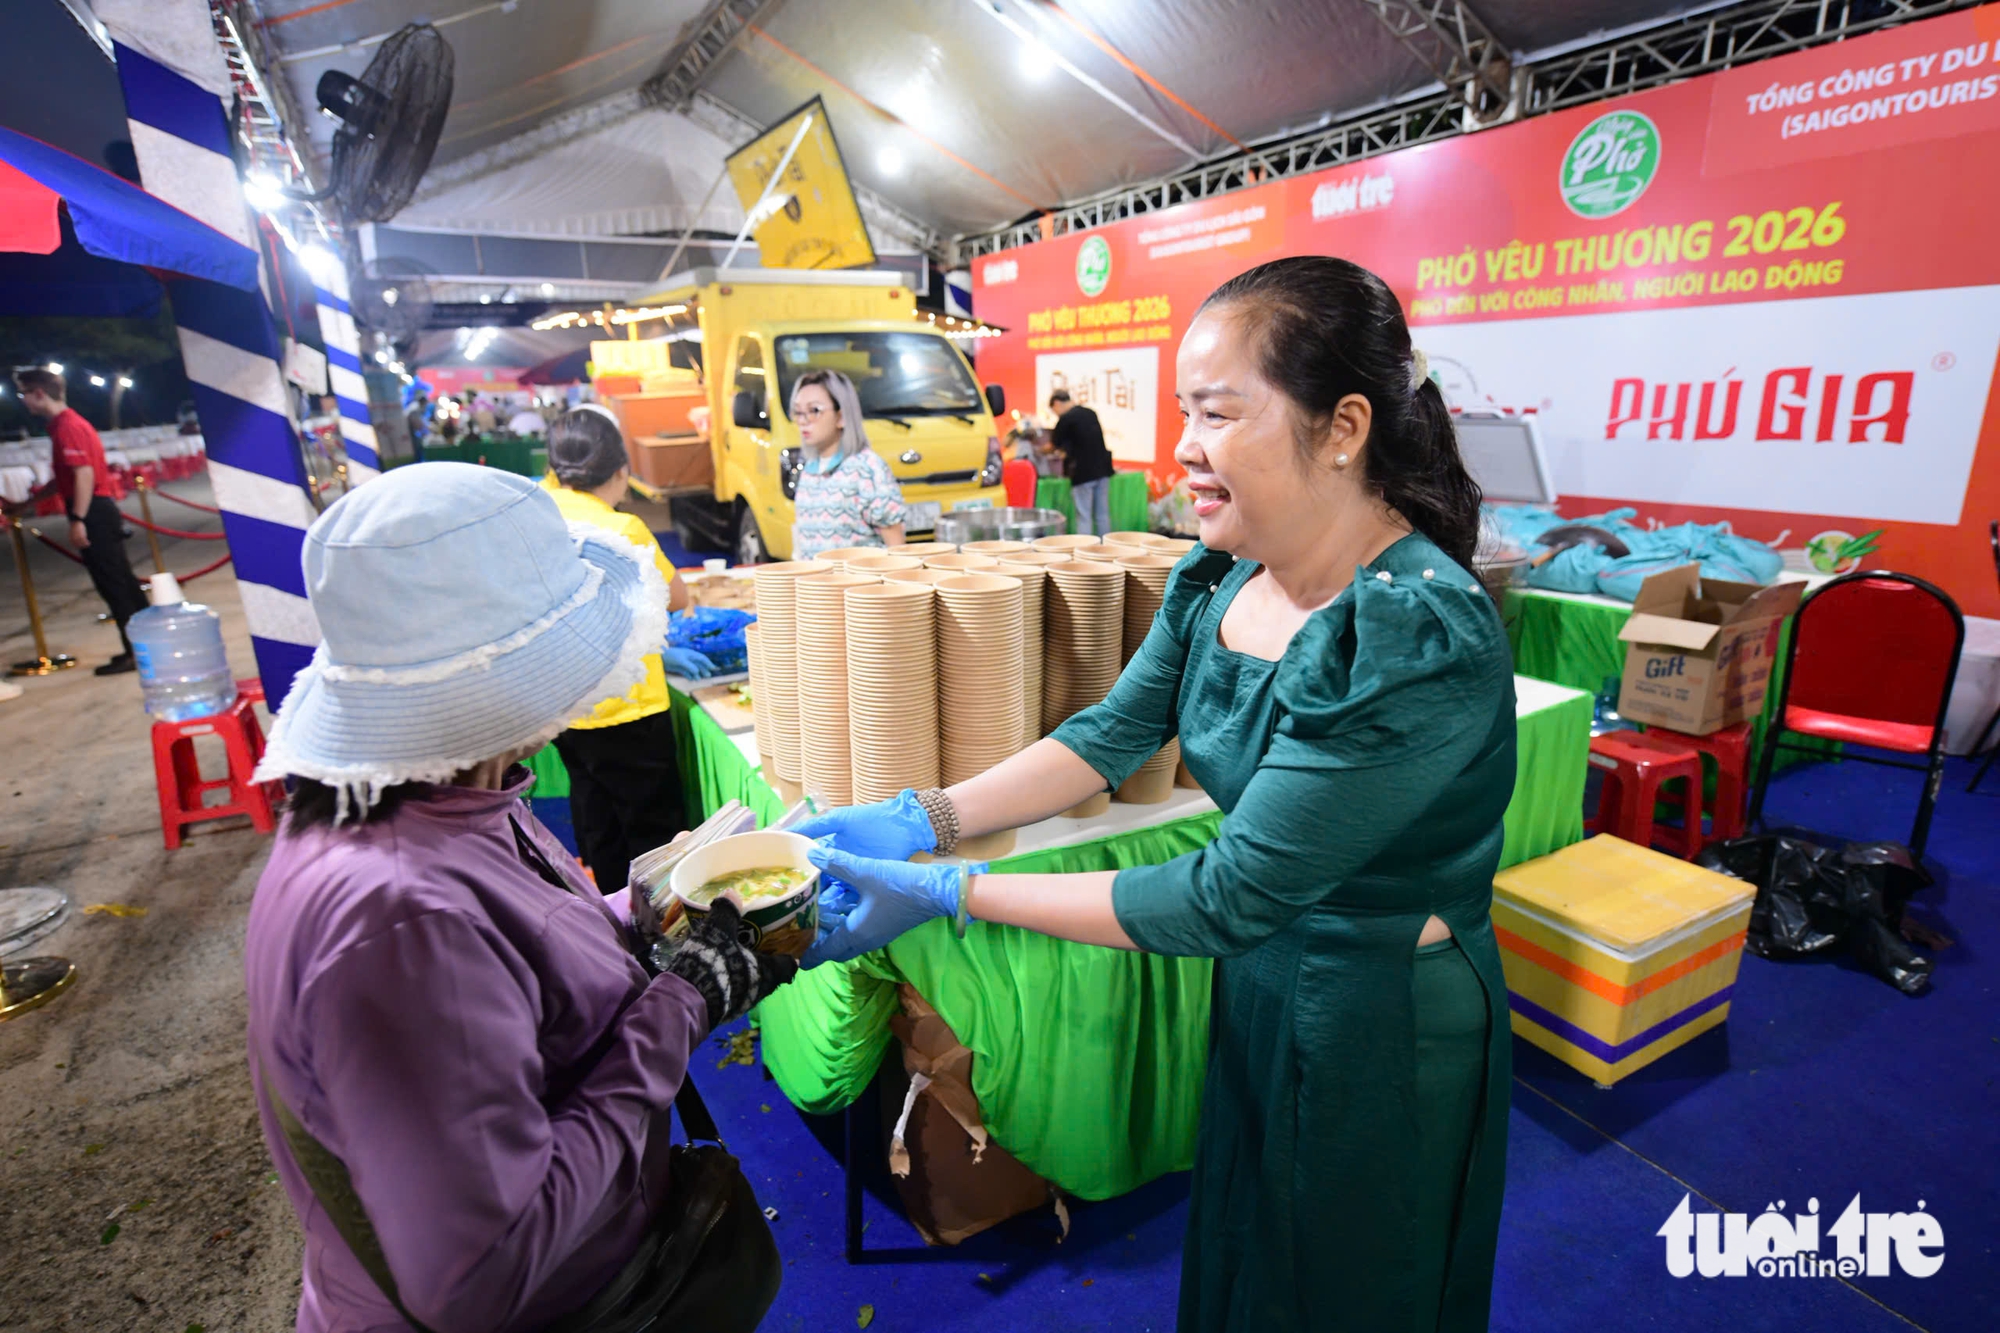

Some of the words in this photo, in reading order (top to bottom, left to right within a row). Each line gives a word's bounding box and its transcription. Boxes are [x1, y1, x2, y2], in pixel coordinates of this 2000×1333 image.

[1818, 62, 1896, 99] CÔNG
[1900, 52, 1938, 82] TY
[1940, 40, 1989, 73] DU
[1780, 74, 2000, 140] (SAIGONTOURIS
[1569, 131, 1648, 186] Phở
[1416, 243, 1478, 291] PHỞ
[1484, 238, 1546, 284] YÊU
[1553, 219, 1714, 276] THƯƠNG
[1722, 200, 1846, 258] 2026
[1512, 285, 1564, 310] CÔNG
[1709, 266, 1759, 295] LAO
[1763, 258, 1845, 291] ĐỘNG
[1604, 366, 1744, 442] PHÚ
[1754, 366, 1915, 445] GIA
[1645, 654, 1686, 679] Gift
